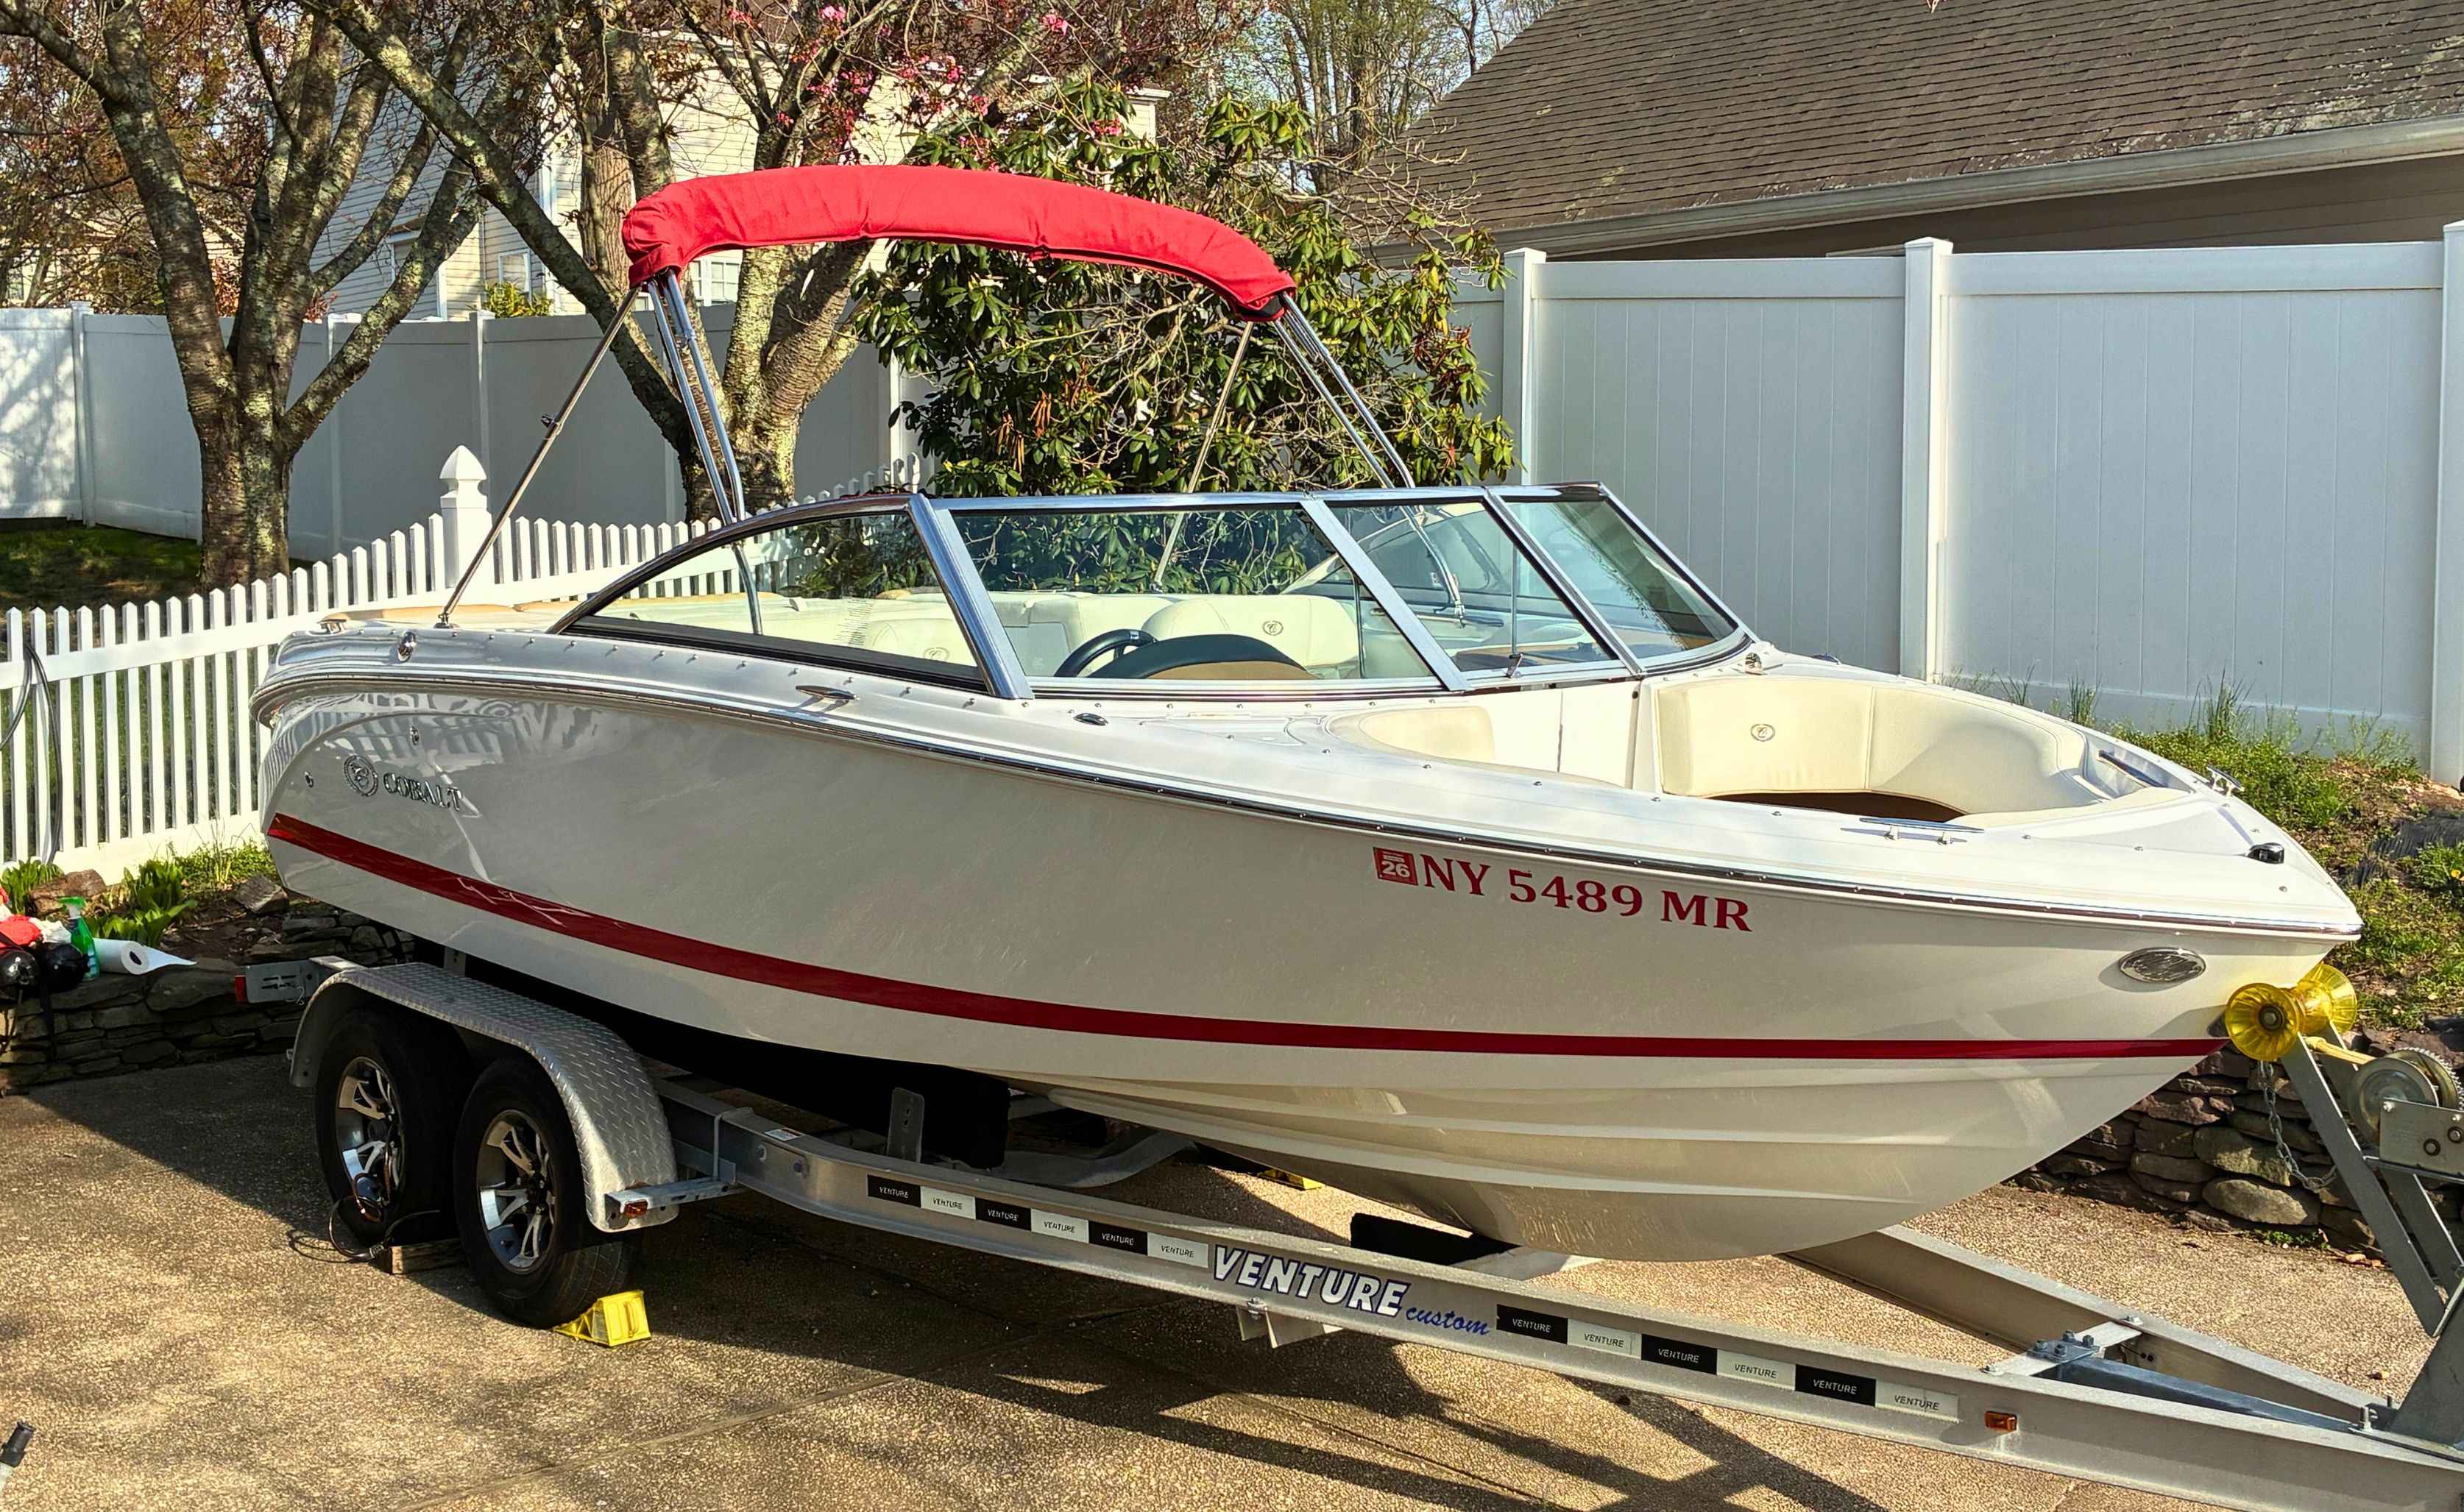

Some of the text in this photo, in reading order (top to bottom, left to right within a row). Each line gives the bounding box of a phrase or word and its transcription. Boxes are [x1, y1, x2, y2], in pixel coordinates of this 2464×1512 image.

[383, 773, 462, 812] COBALT
[1381, 860, 1411, 878] 26
[1420, 853, 1753, 932] NY 5489 MR
[879, 1187, 909, 1199] VENTURE
[933, 1198, 963, 1210] VENTURE
[988, 1209, 1019, 1221] VENTURE
[1044, 1221, 1075, 1233] VENTURE
[1102, 1232, 1134, 1245] VENTURE
[1161, 1245, 1194, 1257] VENTURE
[1214, 1244, 1412, 1318] VENTURE
[1405, 1305, 1490, 1336] custom
[1512, 1318, 1551, 1332] VENTURE
[1584, 1333, 1624, 1347] VENTURE
[1658, 1348, 1699, 1363] VENTURE
[1735, 1364, 1777, 1378] VENTURE
[1813, 1380, 1858, 1394] VENTURE
[1894, 1395, 1940, 1410] VENTURE
